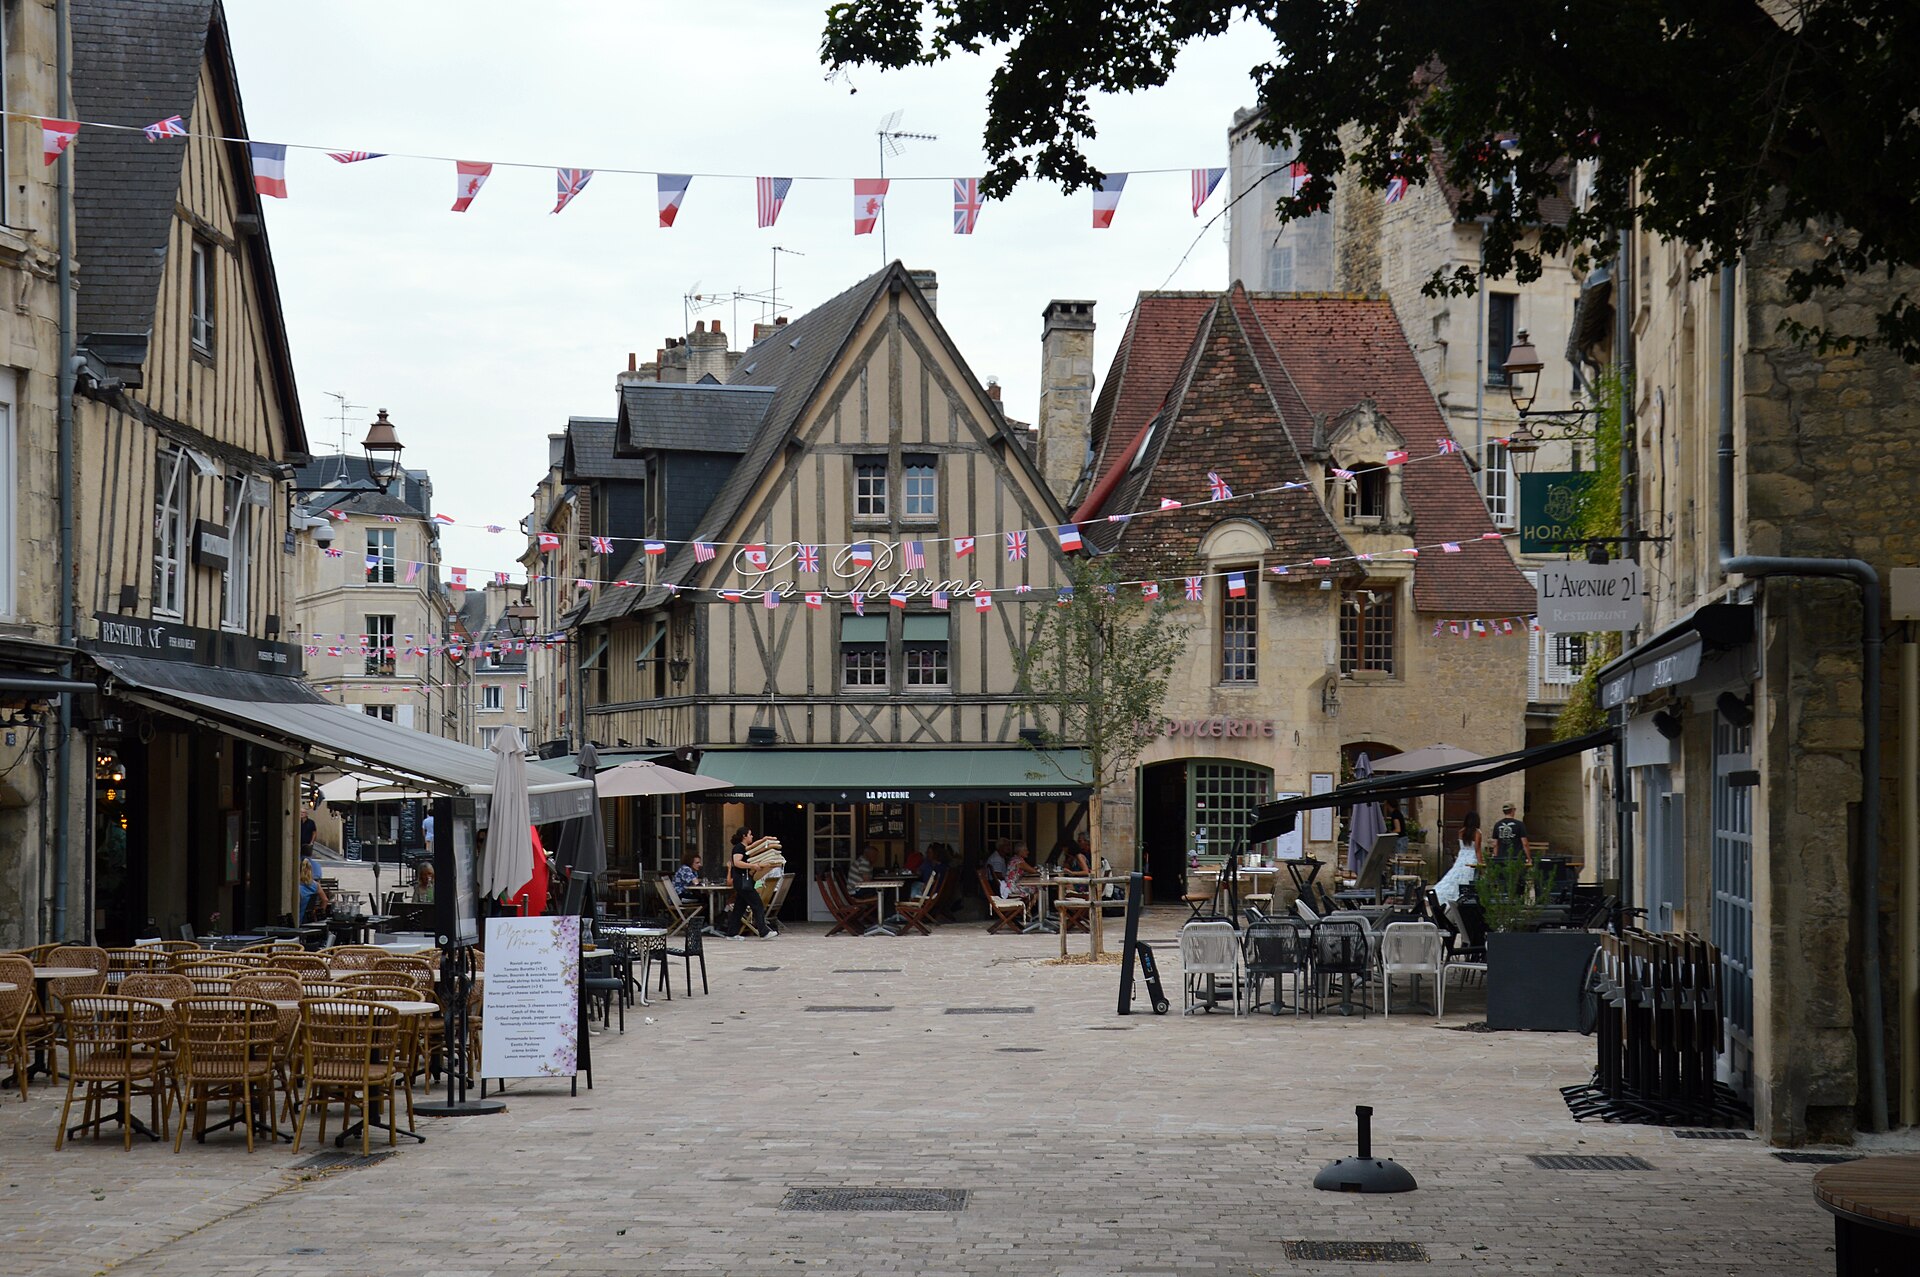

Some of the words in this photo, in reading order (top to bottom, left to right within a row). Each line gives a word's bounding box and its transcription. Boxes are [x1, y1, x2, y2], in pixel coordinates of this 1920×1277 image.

[1524, 525, 1585, 540] HORAC
[717, 541, 802, 599] La
[825, 539, 986, 599] Poterne
[1543, 573, 1616, 598] L'Avenue
[1621, 571, 1637, 601] 21
[1553, 609, 1628, 622] Restaurant
